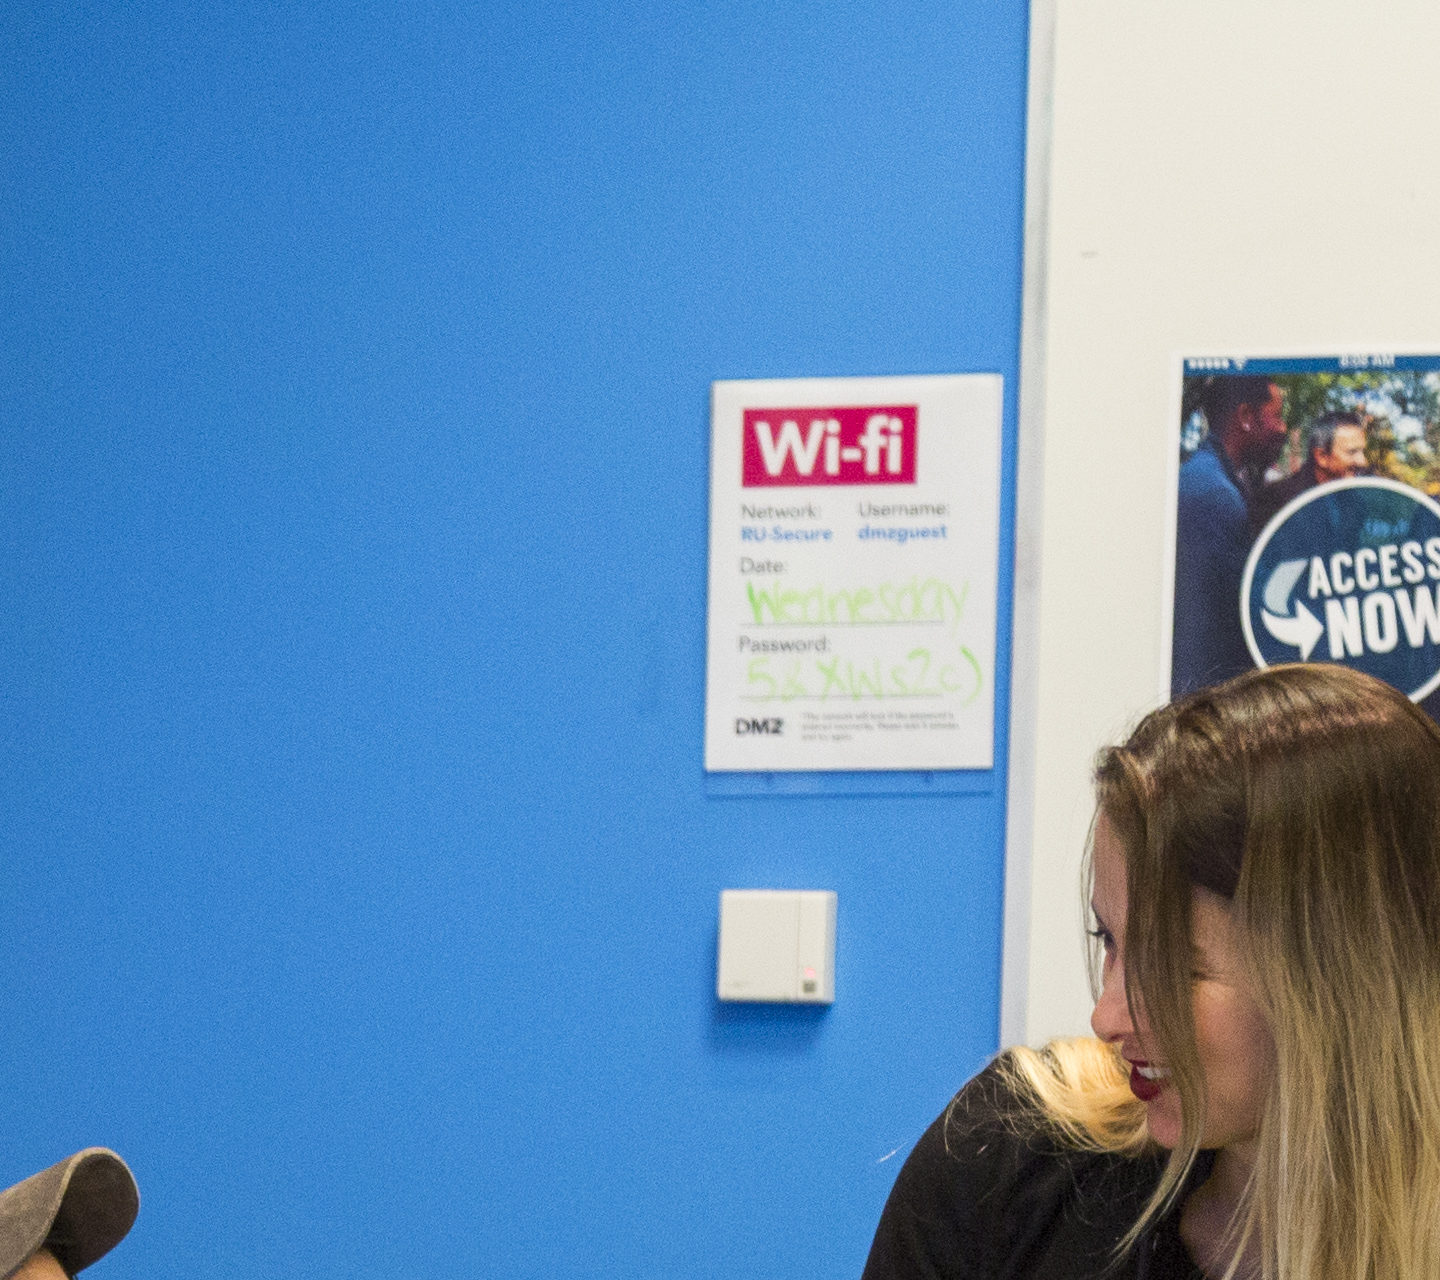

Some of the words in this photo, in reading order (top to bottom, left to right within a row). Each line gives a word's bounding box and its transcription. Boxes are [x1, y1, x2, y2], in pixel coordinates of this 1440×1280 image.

[753, 414, 904, 477] Wi-fi
[858, 502, 949, 518] Username:
[741, 526, 833, 542] RU-Secure
[857, 525, 948, 545] dmzguest
[740, 557, 788, 575] Date:
[738, 635, 831, 653] Password:
